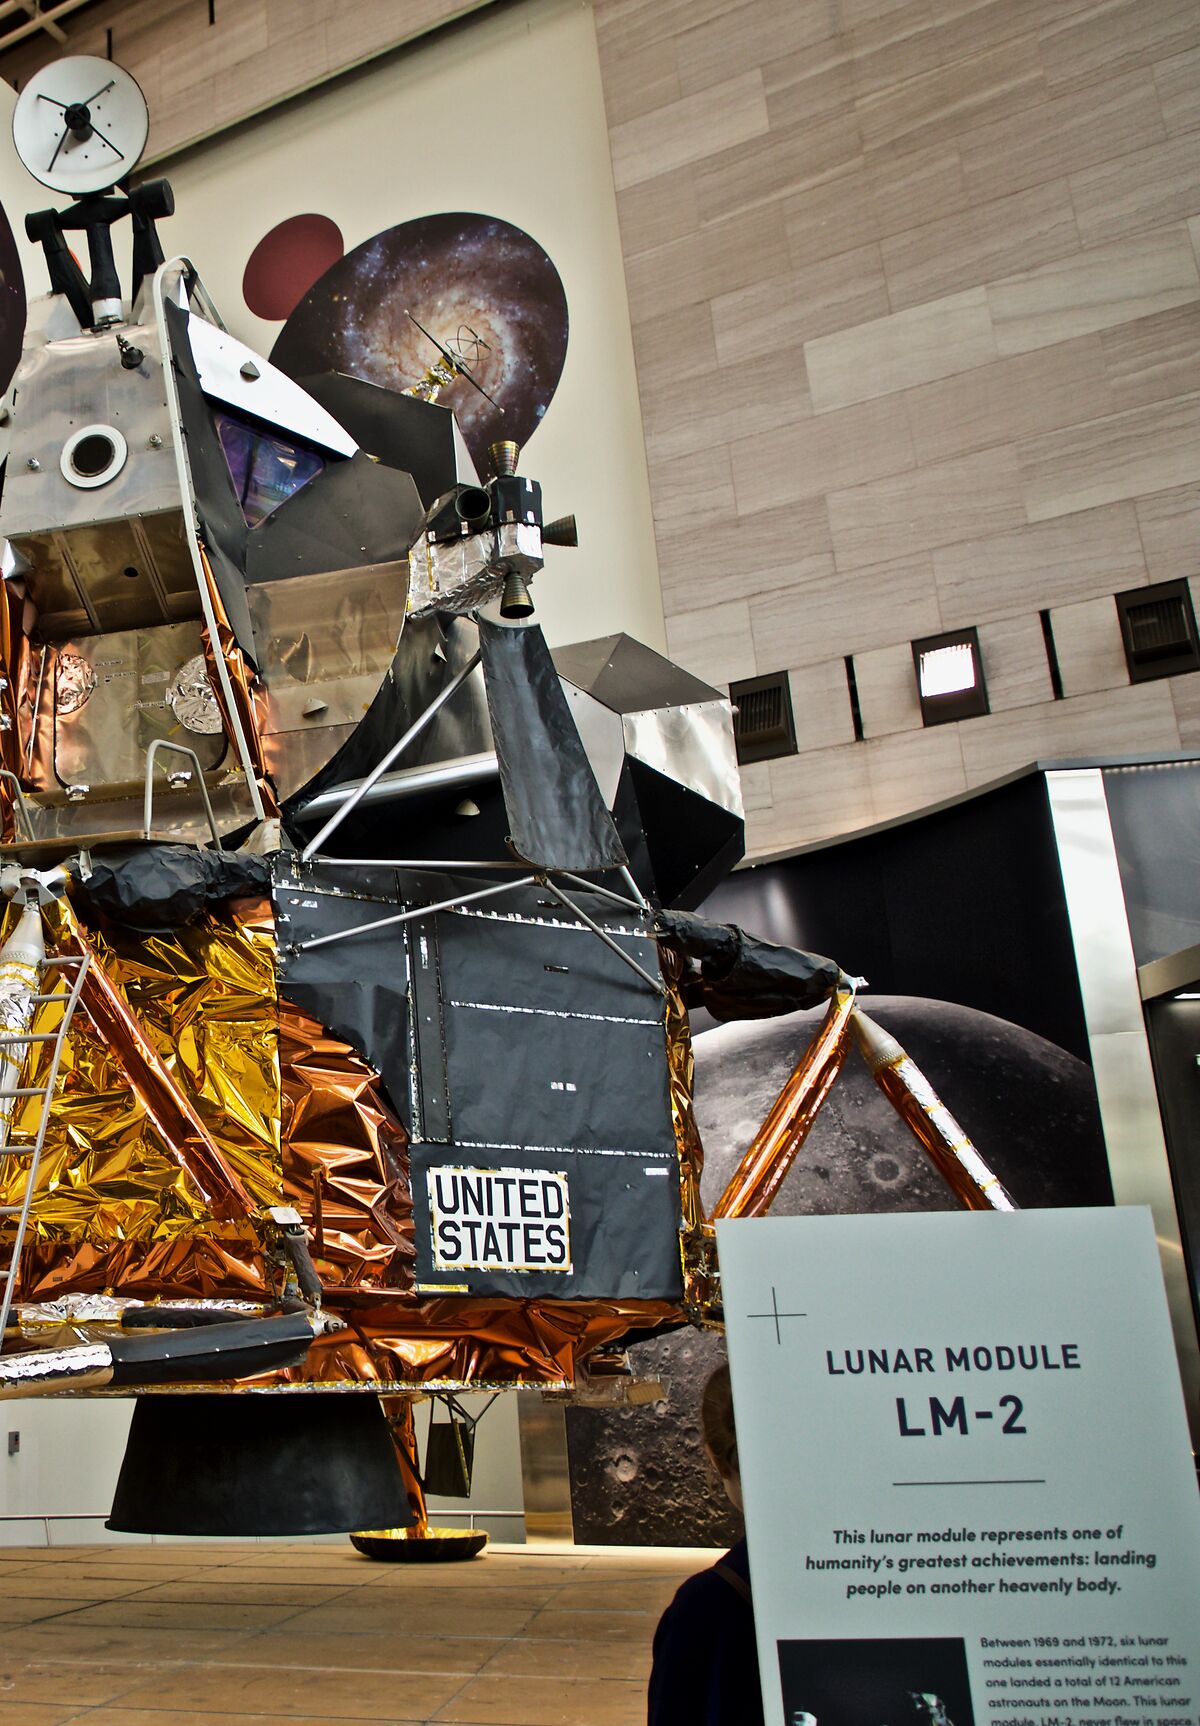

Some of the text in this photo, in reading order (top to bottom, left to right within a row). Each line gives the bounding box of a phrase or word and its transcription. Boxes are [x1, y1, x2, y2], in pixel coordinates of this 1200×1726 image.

[435, 1174, 564, 1219] UNITED
[438, 1220, 566, 1264] STATES
[826, 1343, 1082, 1376] LUNAR MODULE
[895, 1394, 1028, 1437] LM-2
[833, 1524, 1124, 1546] This lunar module represents one of
[898, 1554, 968, 1573] greatest
[971, 1552, 1090, 1568] achievements:
[1094, 1550, 1157, 1569] landing
[846, 1576, 1122, 1600] people on another heavenly body.
[980, 1637, 1031, 1648] Between
[1033, 1637, 1059, 1647] 1969
[1063, 1636, 1085, 1647] and
[1120, 1636, 1135, 1646] six
[1138, 1636, 1169, 1646] lunar
[983, 1655, 1187, 1669] modules essentially identical to this
[1010, 1677, 1051, 1687] landed
[1055, 1679, 1062, 1687] a
[1065, 1676, 1091, 1687] total
[1095, 1676, 1106, 1686] of
[1110, 1676, 1120, 1686] 12
[1124, 1676, 1180, 1686] American
[989, 1698, 1050, 1708] astronauts
[1054, 1699, 1068, 1707] on
[1071, 1697, 1090, 1707] the
[1133, 1696, 1157, 1706] This
[1160, 1697, 1191, 1706] lunar
[991, 1718, 1038, 1726] module
[1041, 1717, 1075, 1726] LM-2
